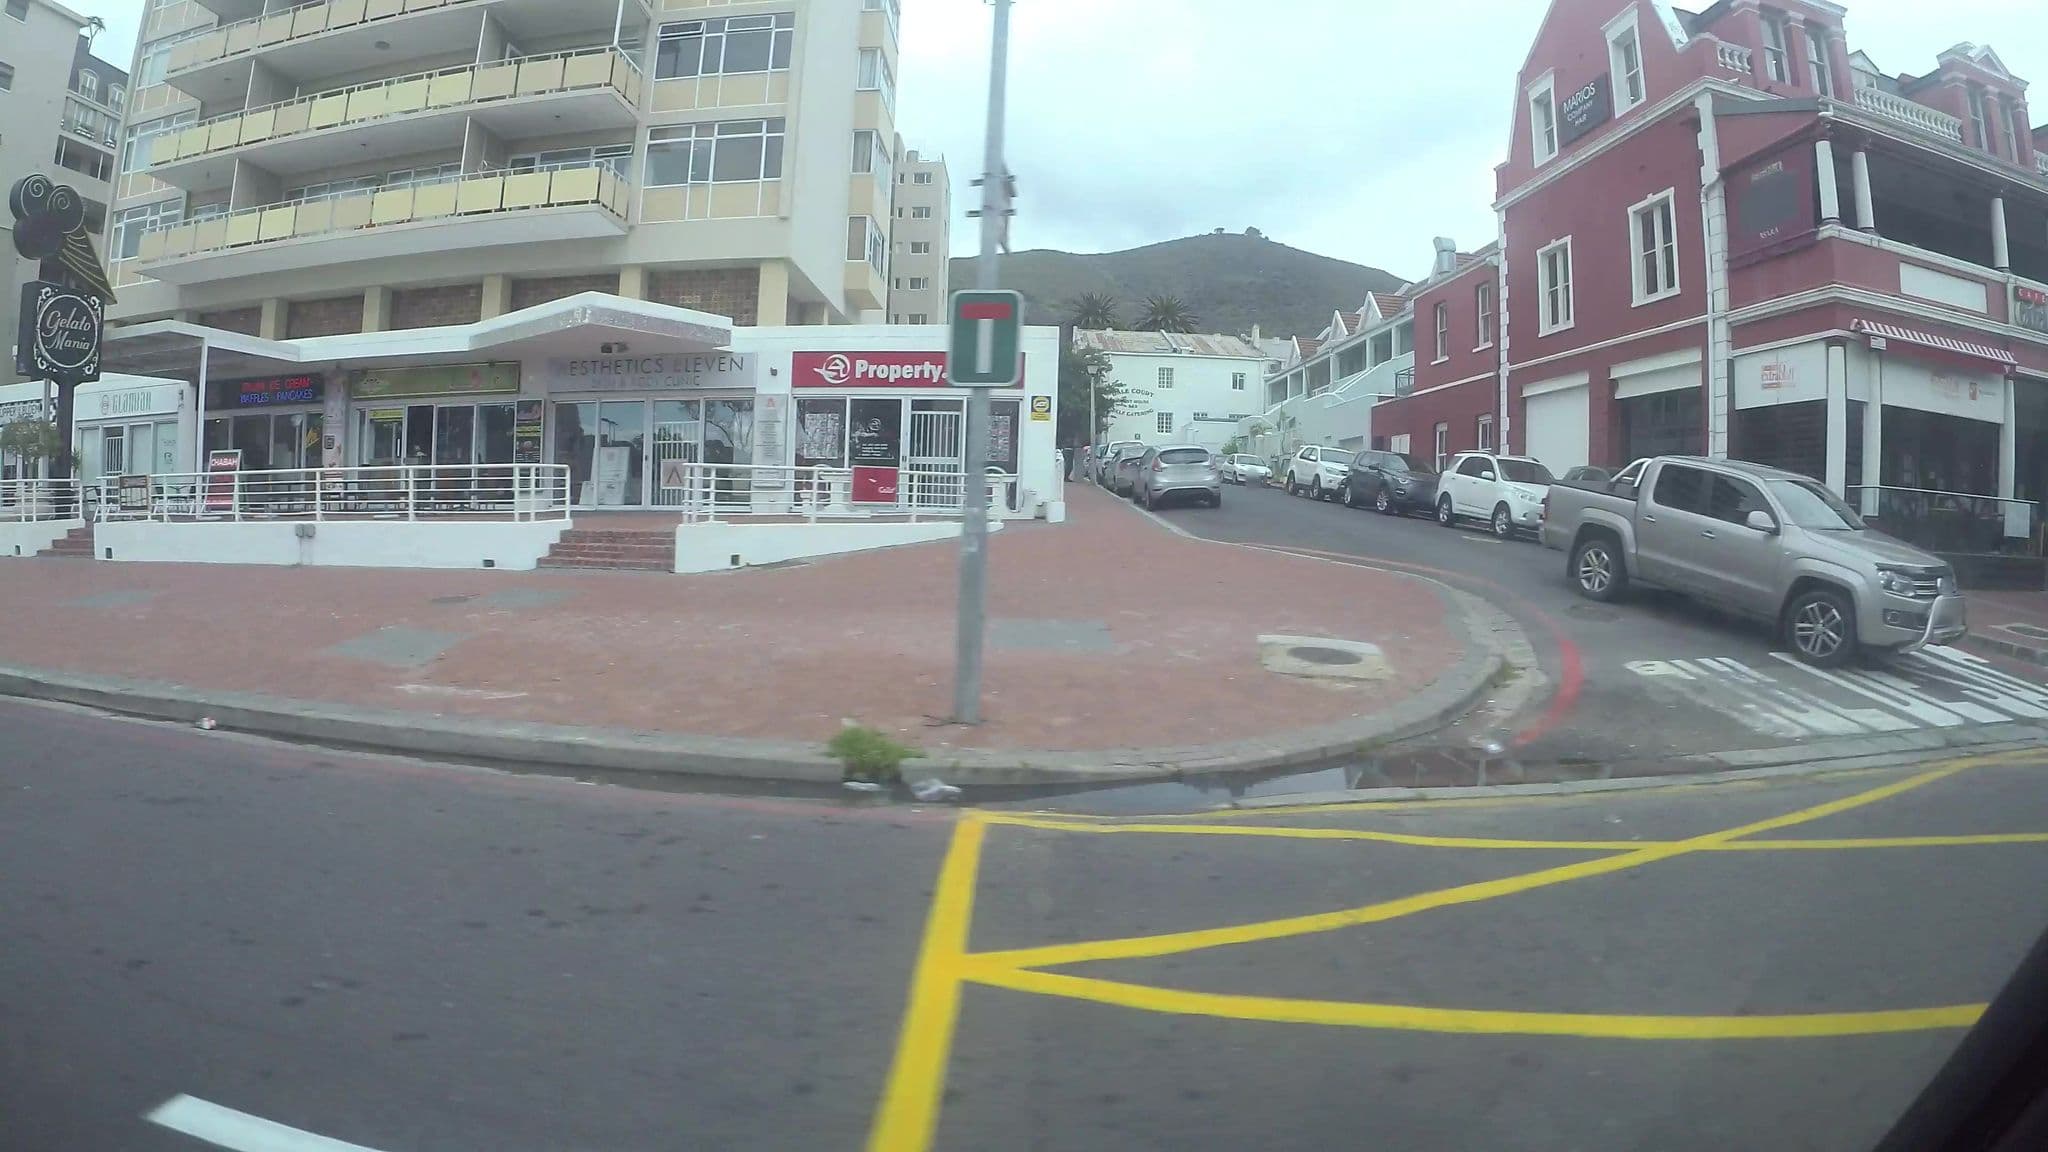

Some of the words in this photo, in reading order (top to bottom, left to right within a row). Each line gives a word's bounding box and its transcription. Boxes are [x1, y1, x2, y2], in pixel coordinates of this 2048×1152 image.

[42, 307, 91, 338] Gelato
[44, 330, 91, 351] Mania
[240, 392, 270, 404] WAFFLES
[276, 389, 313, 401] PANCAKES
